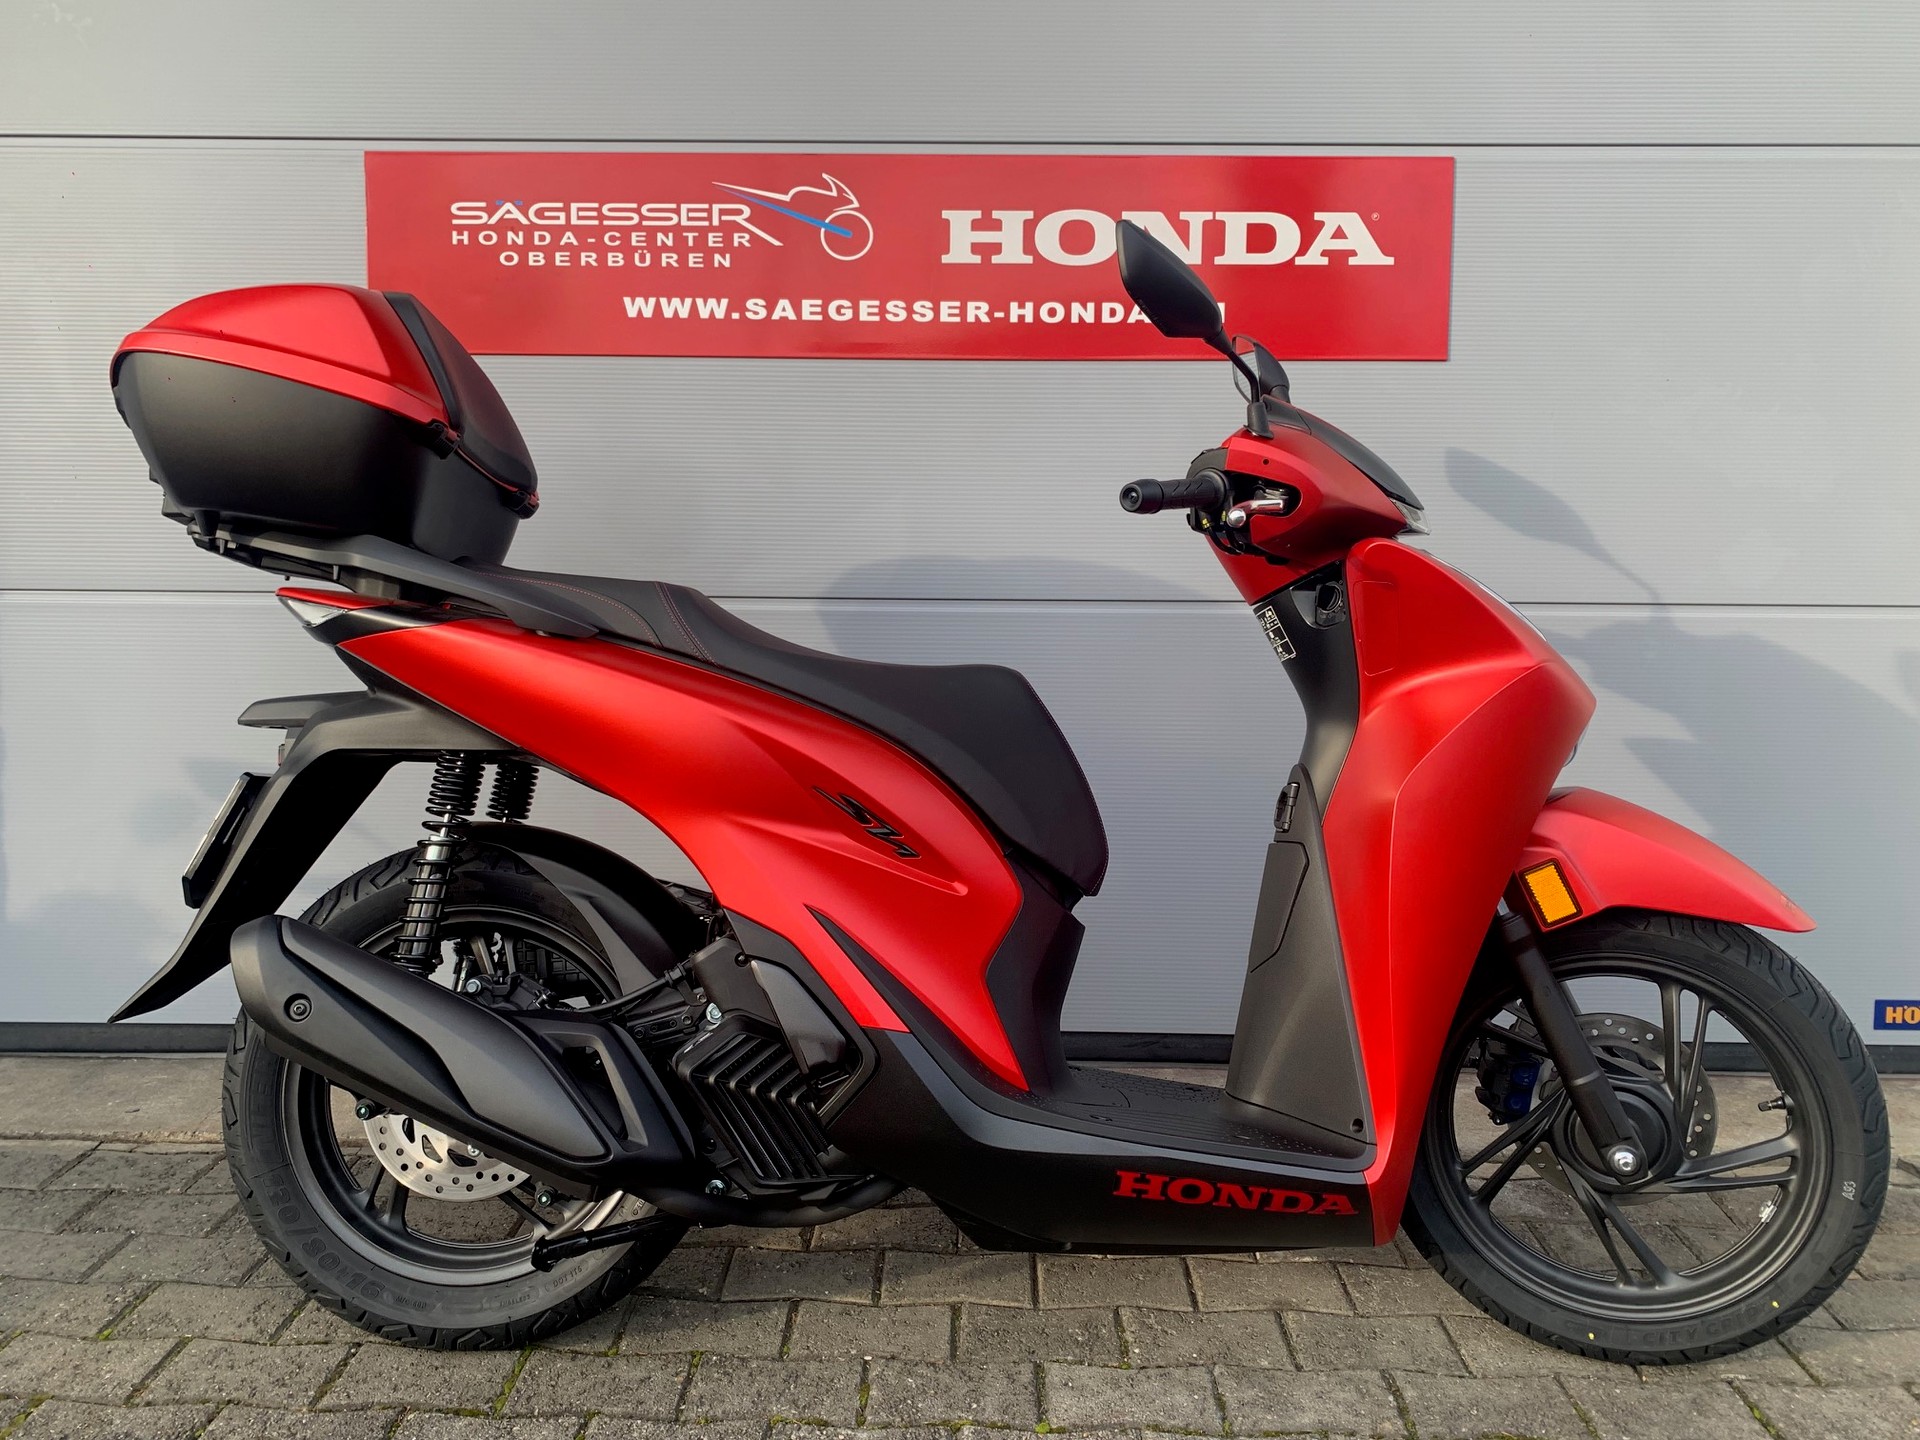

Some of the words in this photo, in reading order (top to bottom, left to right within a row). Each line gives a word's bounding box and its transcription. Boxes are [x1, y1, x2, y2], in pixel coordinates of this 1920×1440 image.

[451, 200, 783, 246] SÄGESSER
[451, 229, 752, 248] HONDA-CENTER
[942, 209, 1395, 266] HONDA
[499, 249, 731, 268] OBERBÜREN
[623, 296, 1226, 324] WWW.SAEGESSER-HONDA
[1112, 1170, 1359, 1215] HONDA
